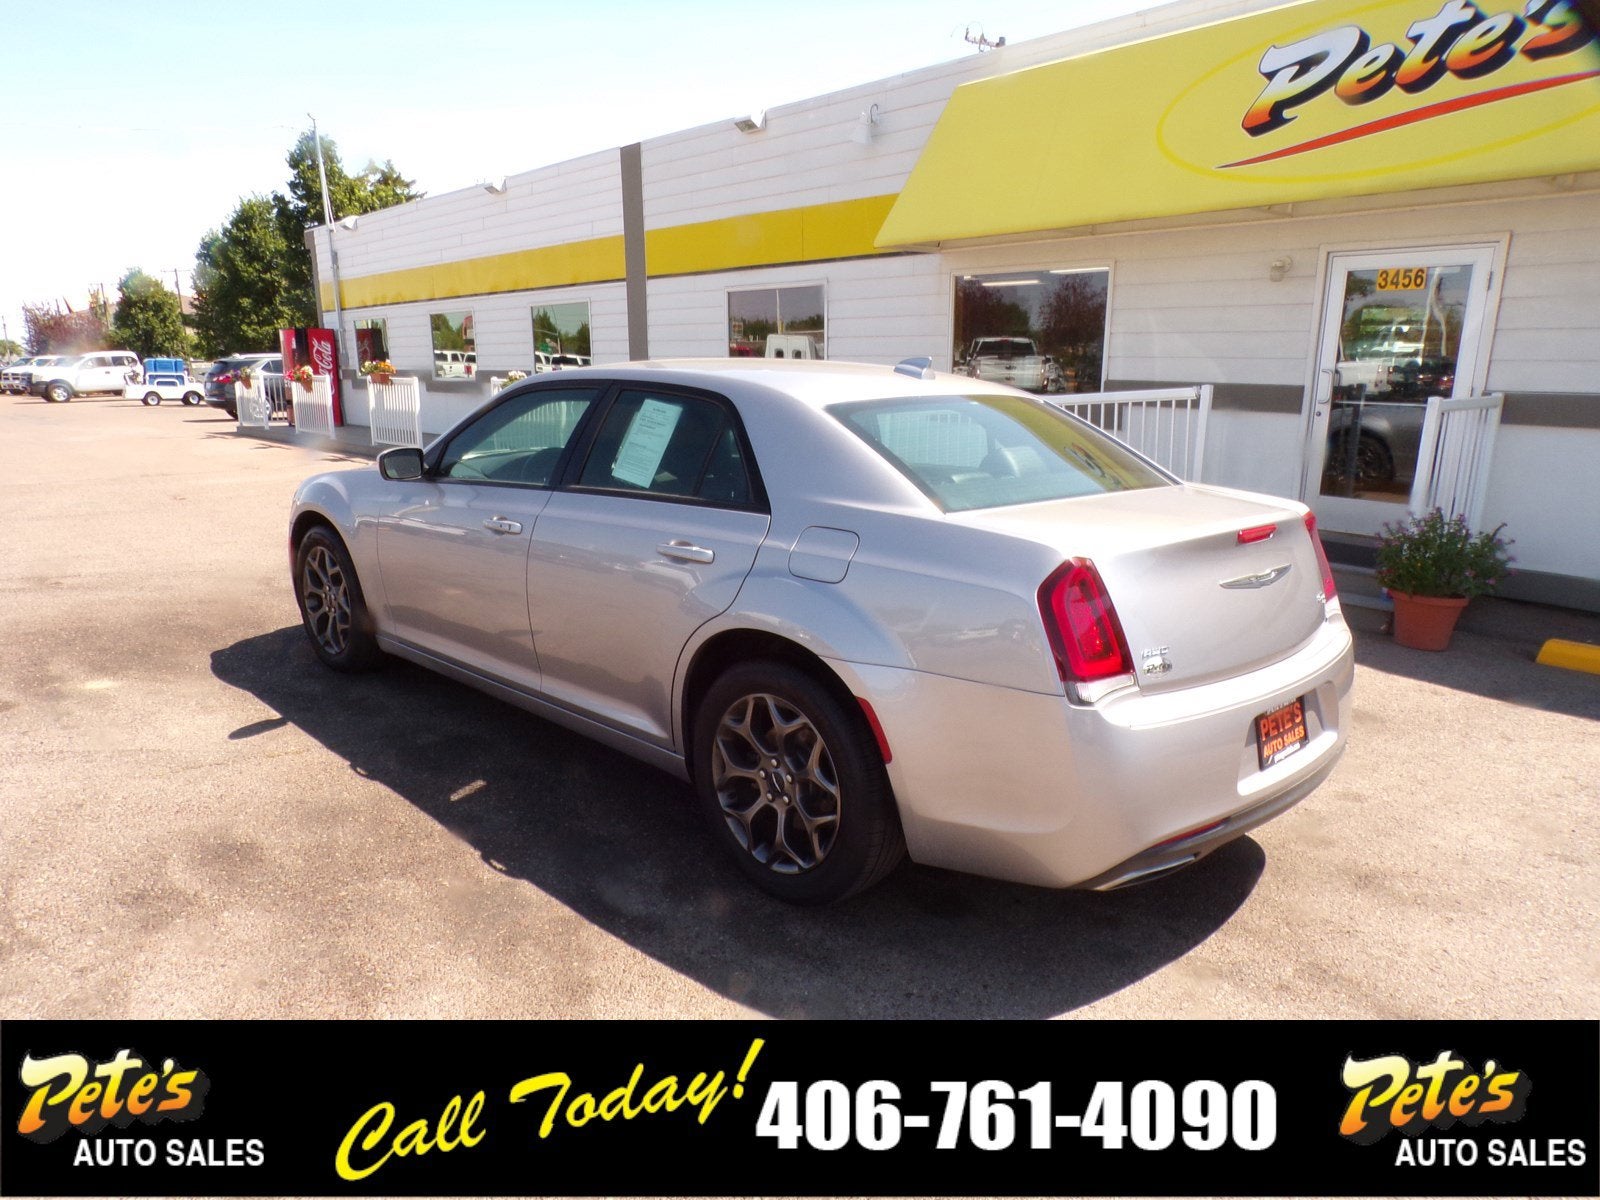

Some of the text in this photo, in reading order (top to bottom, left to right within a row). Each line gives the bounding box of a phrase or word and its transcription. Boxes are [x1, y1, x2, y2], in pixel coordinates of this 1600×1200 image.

[1242, 0, 1592, 137] Pete's
[1377, 268, 1425, 290] 3456
[1260, 701, 1303, 742] PETE'S
[1263, 737, 1284, 759] AUTO
[1283, 724, 1306, 747] SALES
